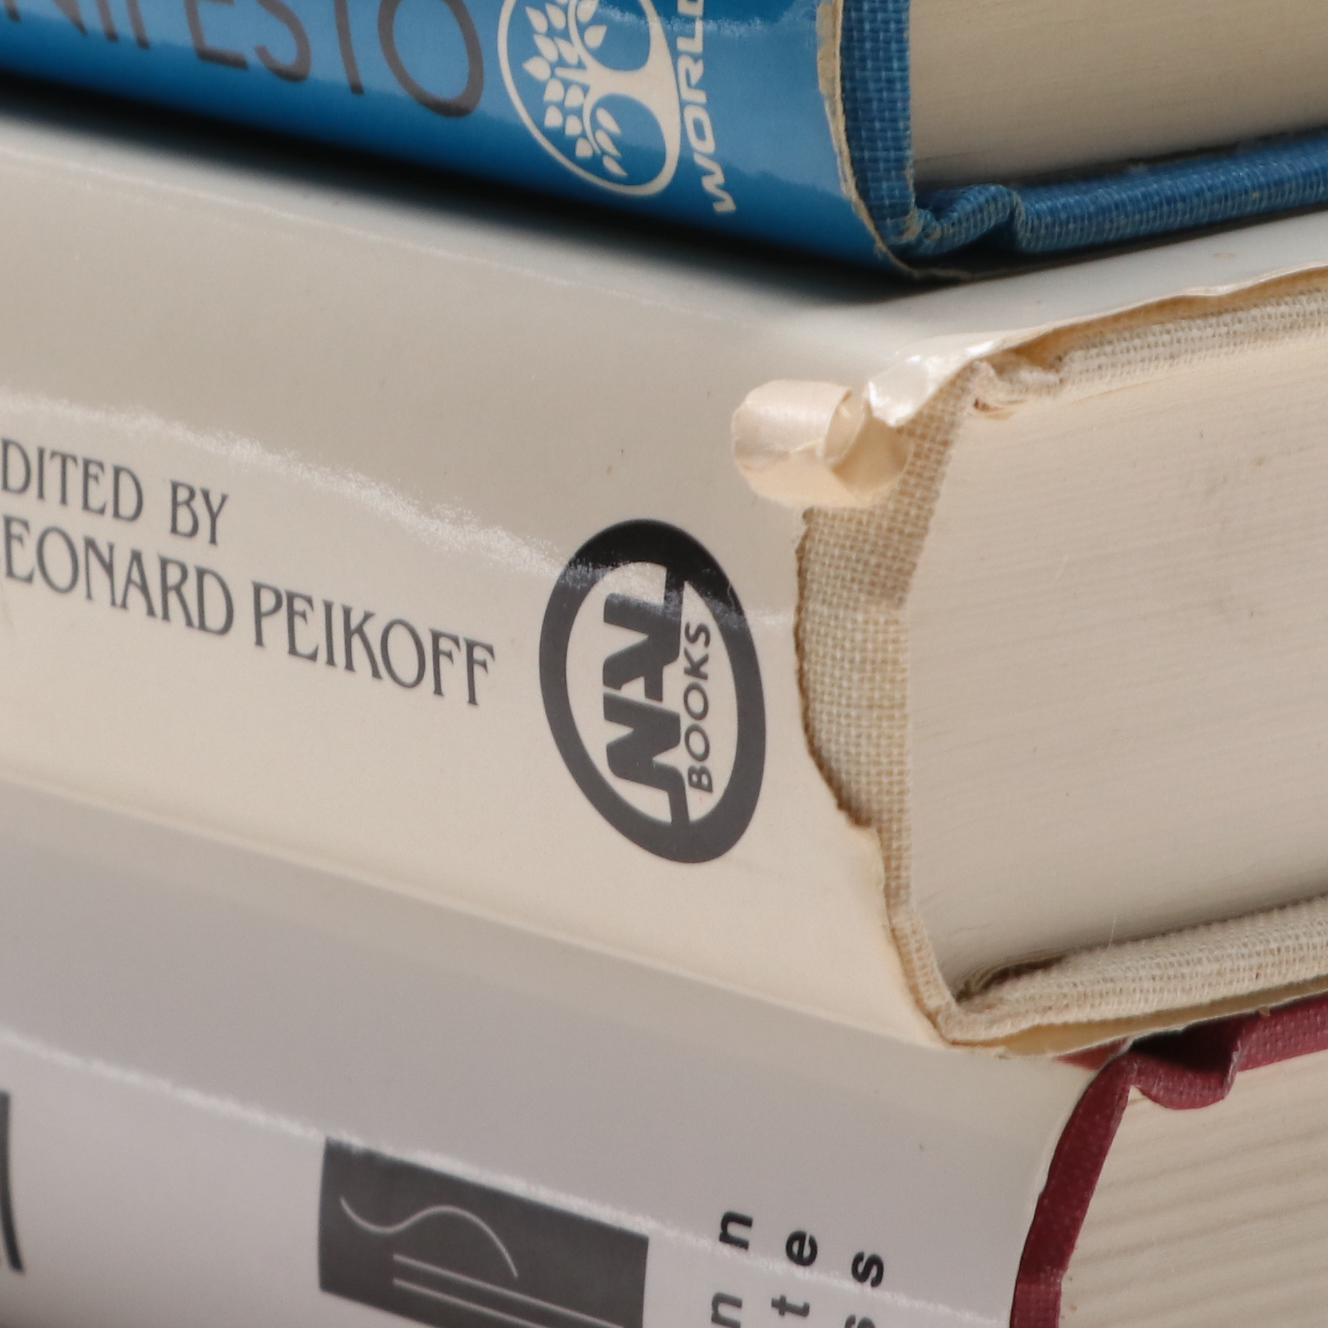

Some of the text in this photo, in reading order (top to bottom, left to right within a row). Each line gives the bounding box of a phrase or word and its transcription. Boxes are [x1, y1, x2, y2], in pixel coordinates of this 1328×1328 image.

[169, 480, 229, 545] BY
[252, 581, 495, 706] PEIKOFF
[683, 623, 713, 793] BOOKS
